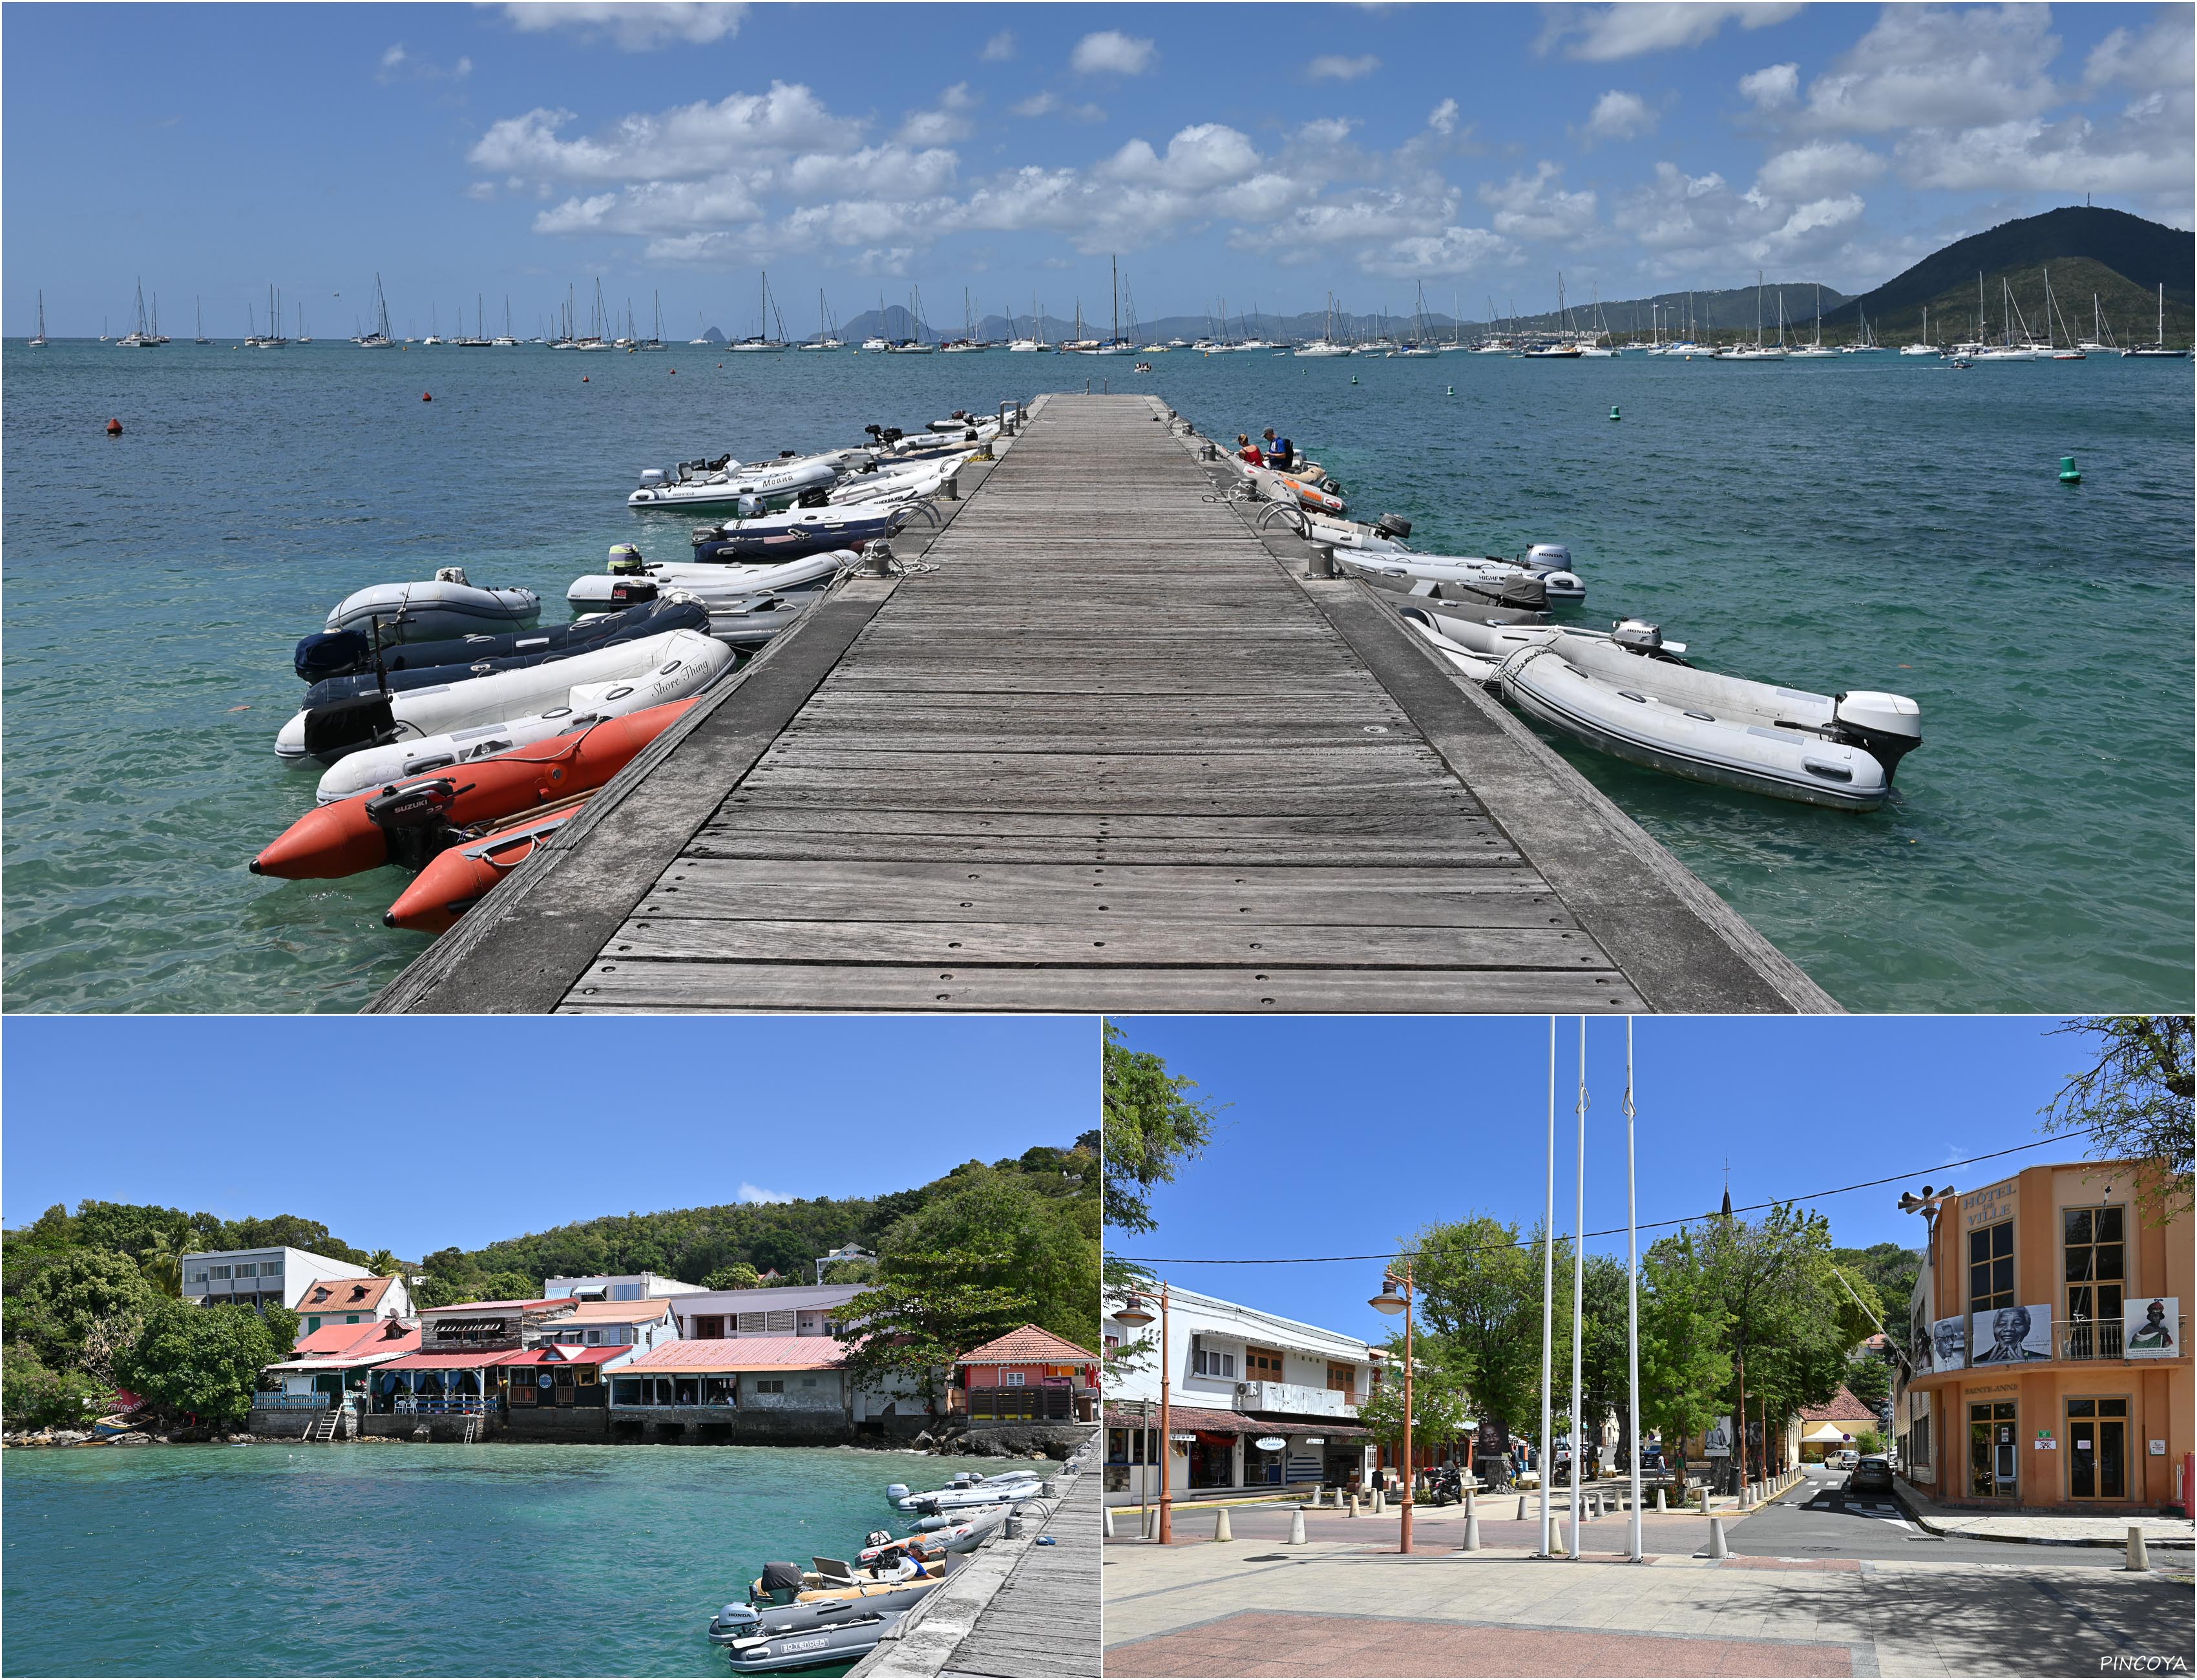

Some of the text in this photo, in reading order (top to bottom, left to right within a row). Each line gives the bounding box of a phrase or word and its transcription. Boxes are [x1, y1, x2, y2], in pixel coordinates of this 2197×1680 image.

[762, 475, 794, 488] Moana
[873, 496, 903, 505] QUICKSILVER
[651, 660, 709, 698] Shore Thing
[394, 799, 428, 814] SUZUKI
[1963, 1183, 2017, 1210] HÔTEL
[1967, 1204, 2012, 1226] VILLE
[1964, 1383, 2019, 1395] SAINTE-ANNE
[794, 1639, 825, 1648] TENDER
